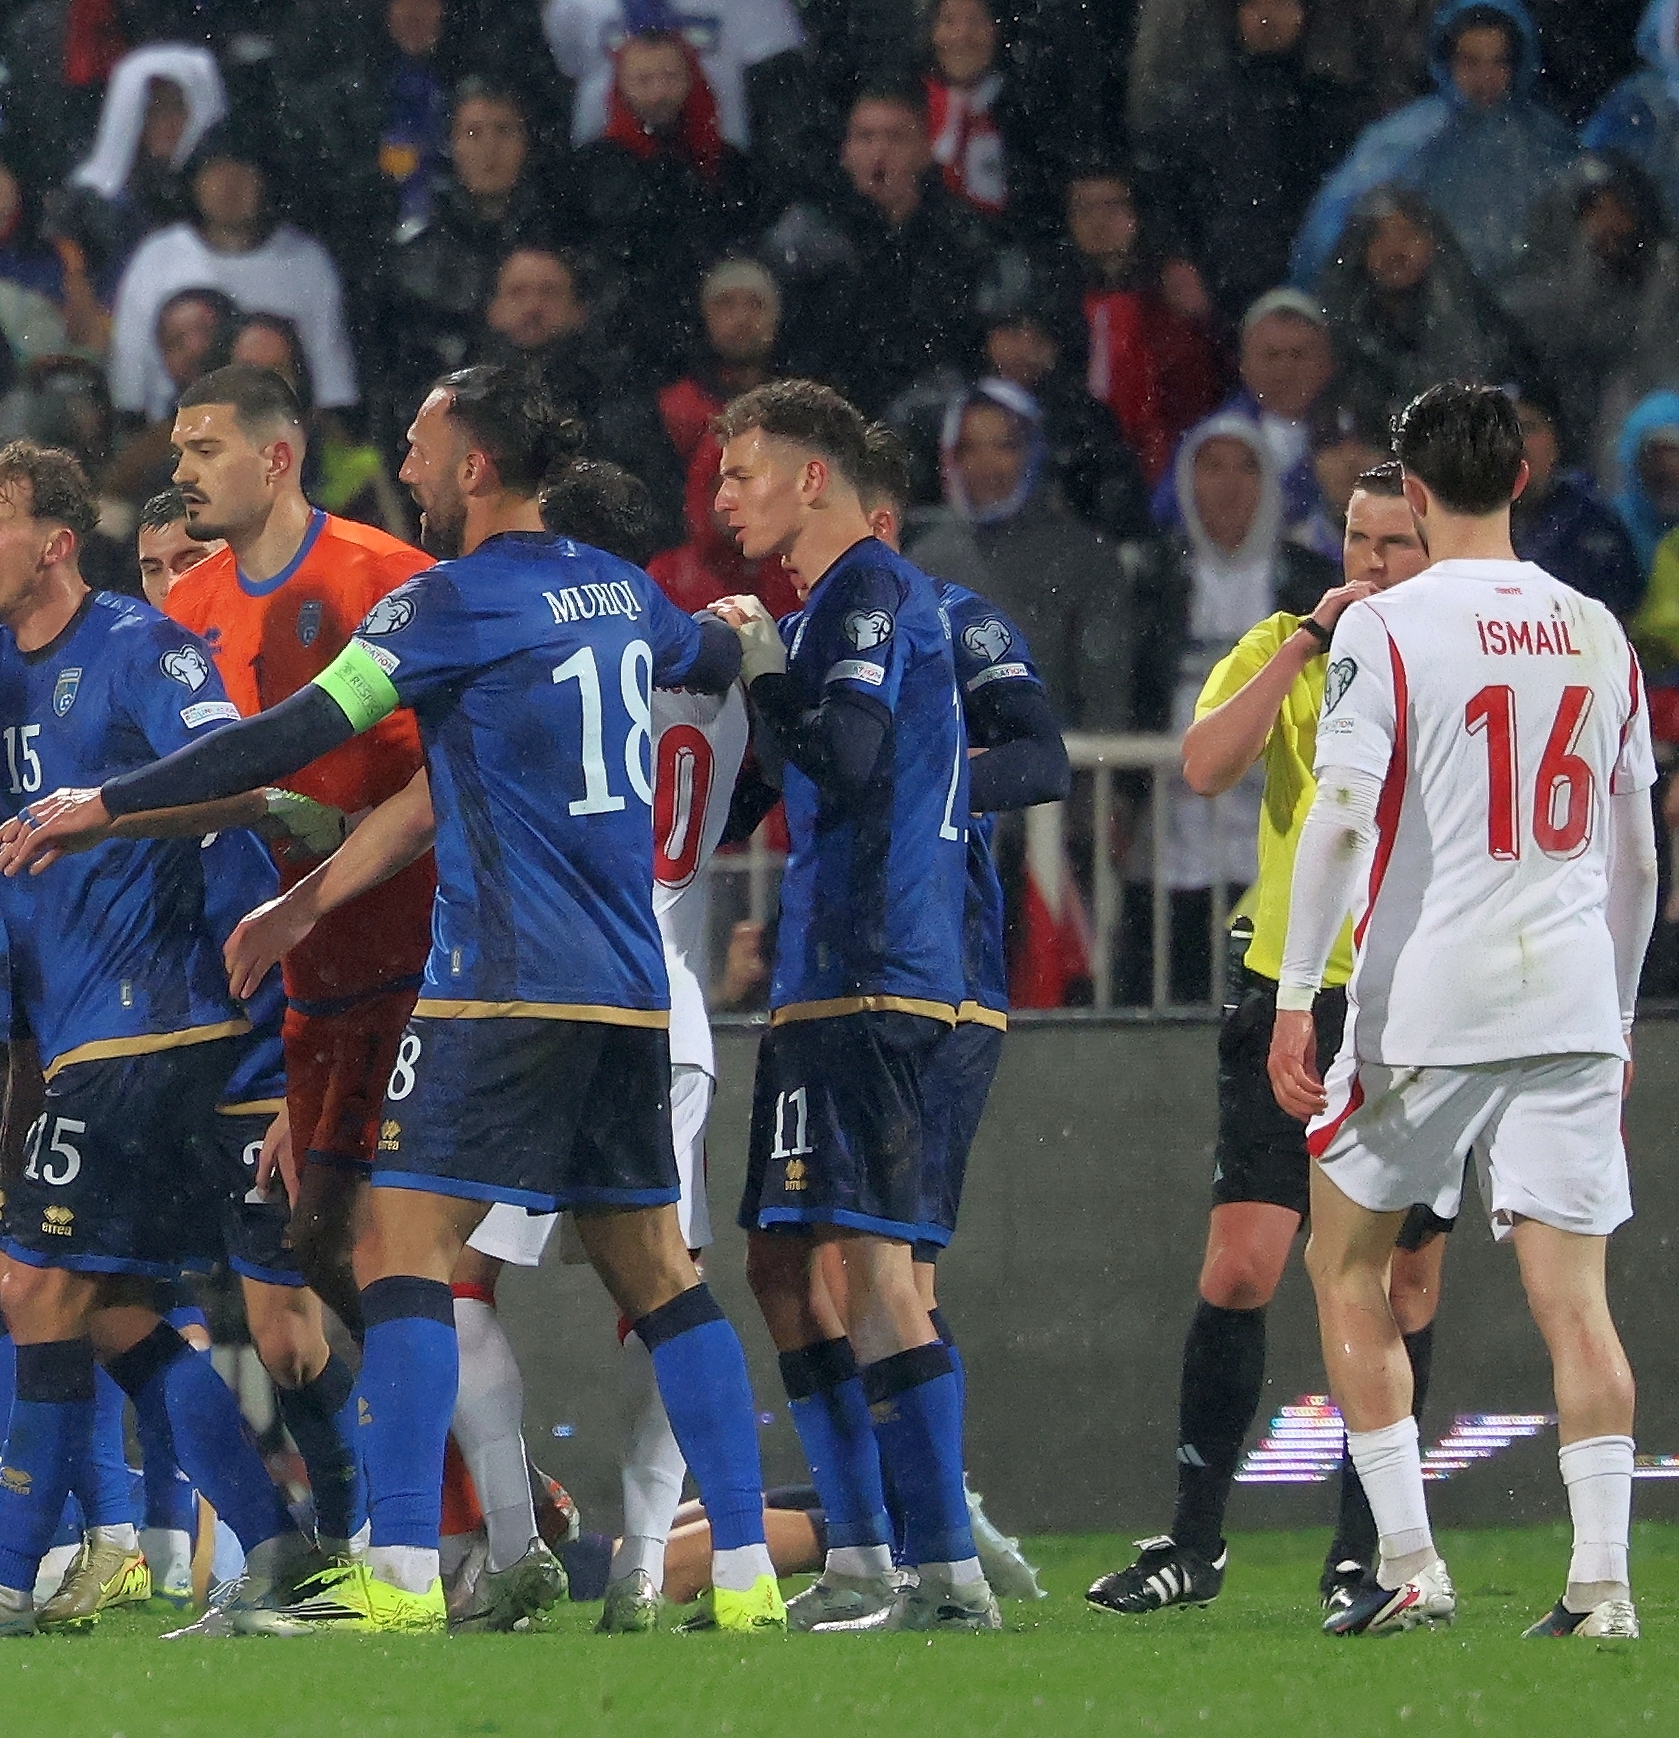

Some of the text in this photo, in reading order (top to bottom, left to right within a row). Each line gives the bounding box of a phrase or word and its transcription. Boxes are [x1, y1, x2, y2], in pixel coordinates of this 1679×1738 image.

[542, 579, 642, 625] MURIQI
[1474, 612, 1582, 656] İSMAİL
[2, 723, 42, 795] 15
[551, 638, 654, 816] 18
[1465, 684, 1595, 862] 16
[387, 1035, 422, 1101] 8
[22, 1111, 87, 1185] 15
[769, 1086, 814, 1160] 11
